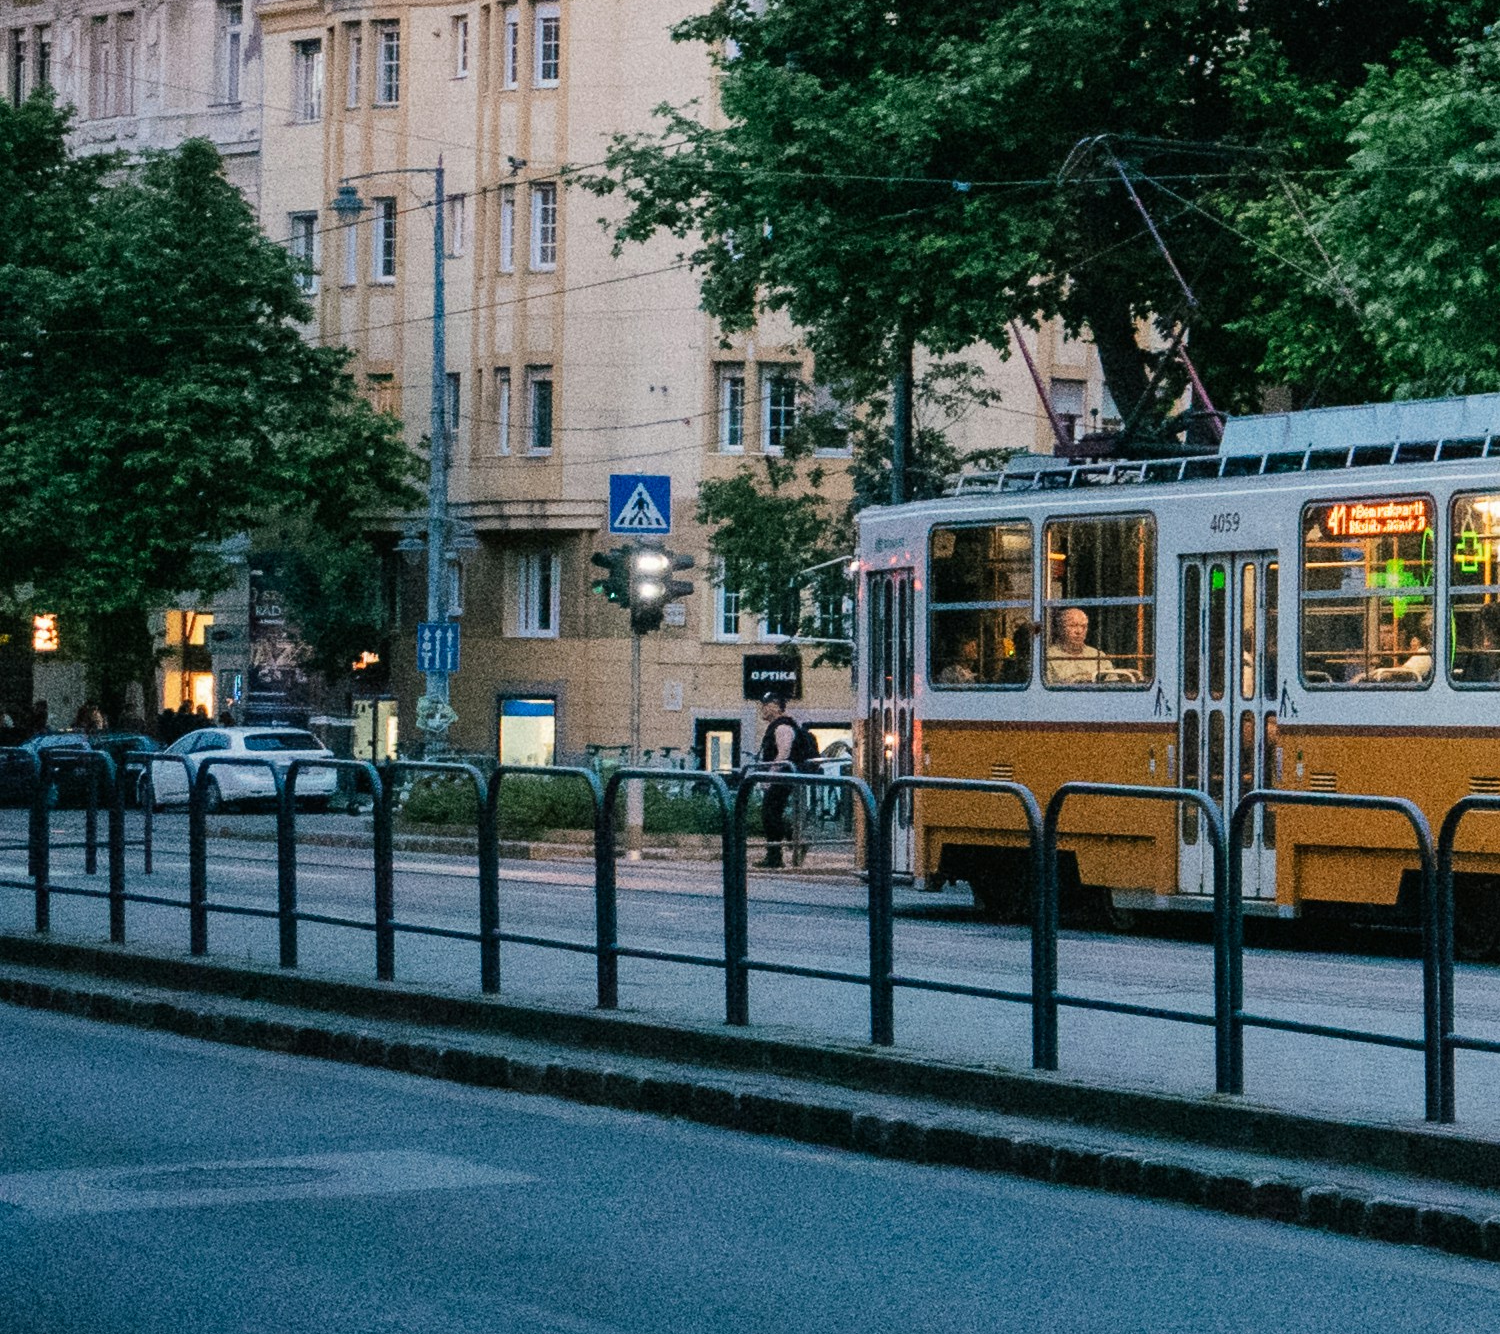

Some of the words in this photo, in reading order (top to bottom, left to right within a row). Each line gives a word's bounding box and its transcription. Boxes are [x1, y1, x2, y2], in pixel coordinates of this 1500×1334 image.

[1210, 513, 1239, 534] 4059
[1328, 505, 1346, 536] 41
[751, 671, 797, 681] OPTIKA
